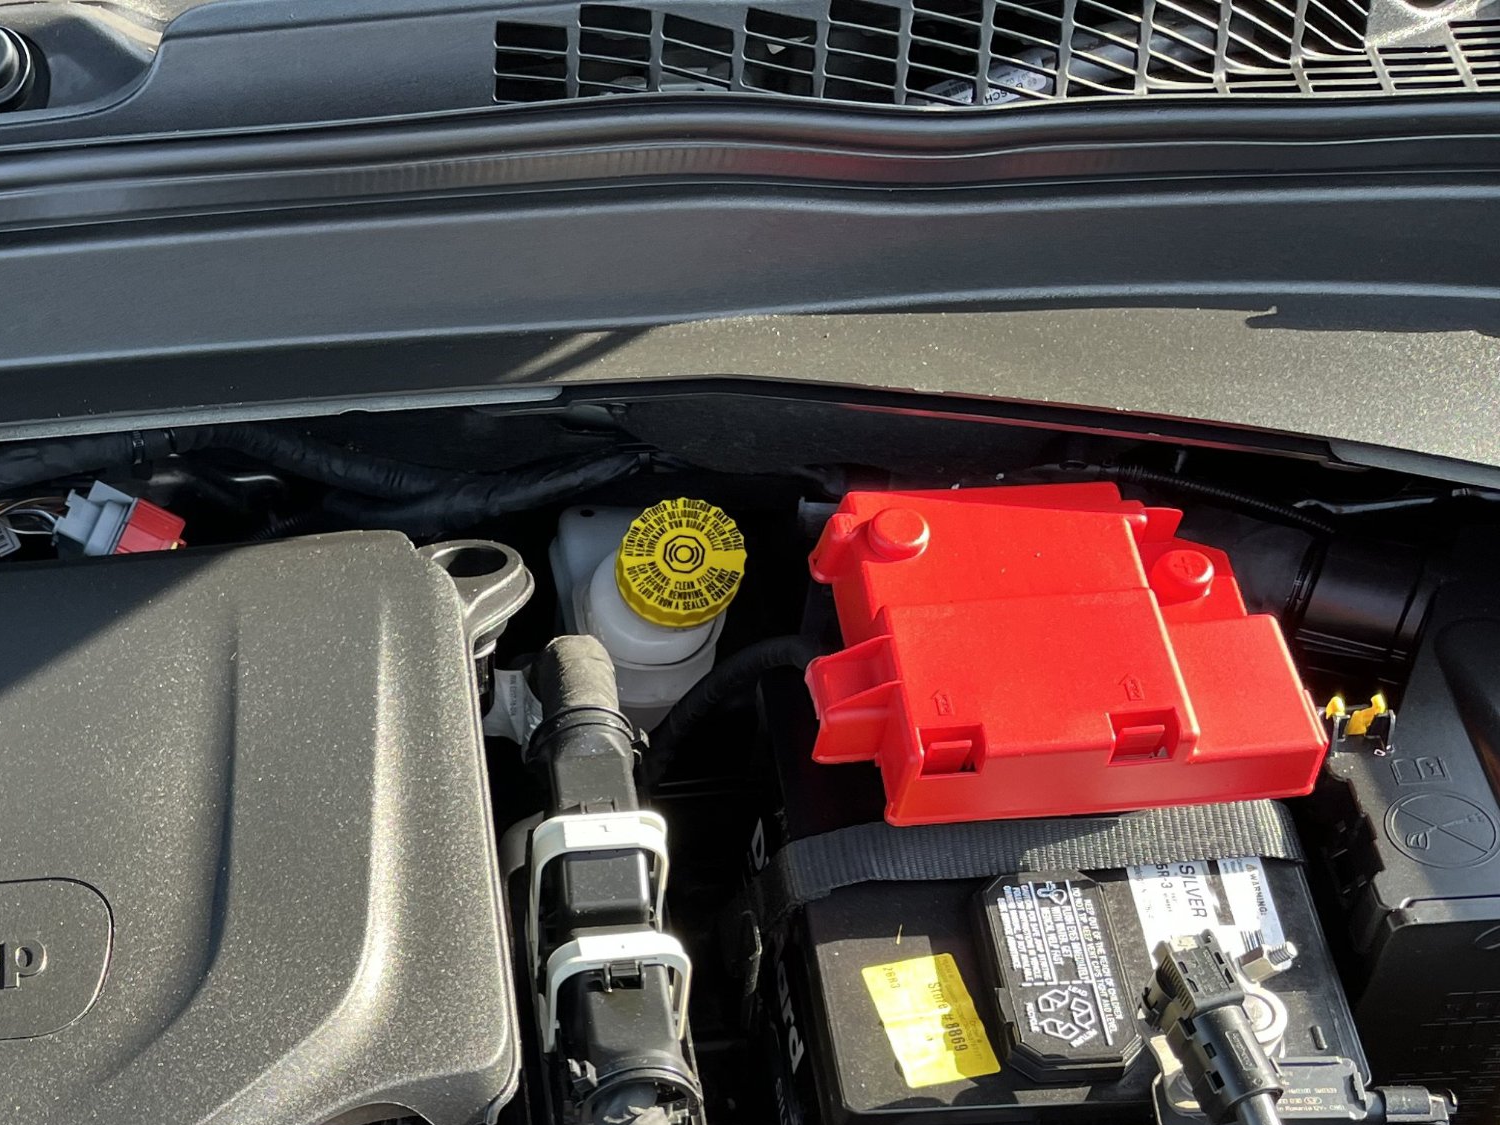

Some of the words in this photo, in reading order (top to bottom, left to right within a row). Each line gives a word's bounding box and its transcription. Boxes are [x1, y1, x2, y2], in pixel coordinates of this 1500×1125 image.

[697, 566, 719, 586] FILLER
[674, 601, 680, 610] A
[682, 597, 710, 610] SEALED
[1178, 863, 1208, 919] SILVER
[1074, 898, 1085, 912] NOT
[1083, 898, 1096, 916] KEEP
[1061, 905, 1075, 925] FLUSH
[1088, 916, 1100, 931] OUT
[1047, 932, 1059, 950] HELP
[1051, 906, 1063, 921] WITH
[1061, 944, 1073, 959] GET
[1066, 925, 1079, 942] EYES
[1082, 926, 1093, 941] KEEP
[1092, 931, 1103, 942] OF
[1095, 941, 1106, 955] THE
[1091, 960, 1103, 978] CAPS
[1098, 955, 1112, 977] REACH
[1096, 979, 1108, 998] TIGHT
[1104, 977, 1115, 988] OF
[1101, 999, 1112, 1013] AND
[1107, 988, 1124, 1020] CHILDREN
